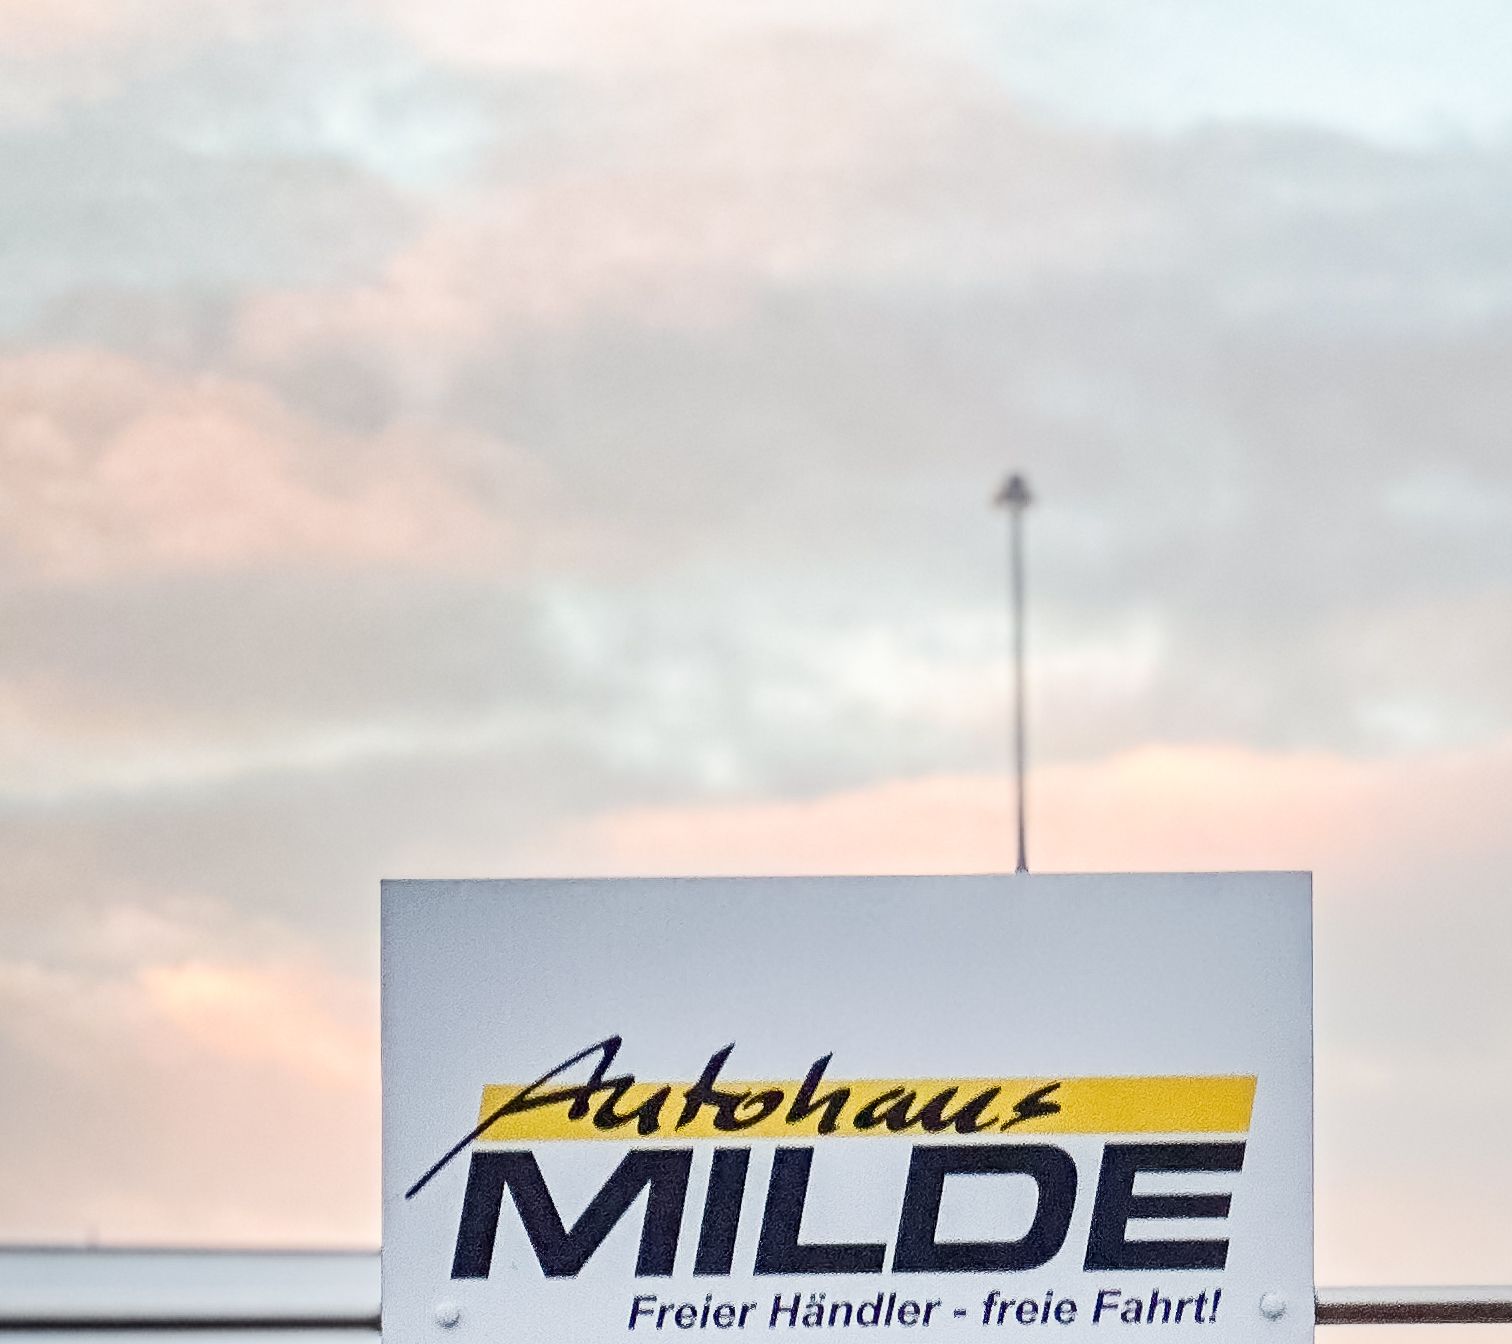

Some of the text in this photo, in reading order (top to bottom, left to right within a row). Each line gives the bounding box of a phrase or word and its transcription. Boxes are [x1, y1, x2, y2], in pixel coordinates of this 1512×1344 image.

[405, 1034, 1062, 1200] Autohaus
[450, 1141, 1248, 1280] MILDE
[627, 1292, 758, 1330] Freier
[768, 1289, 943, 1329] Händler
[982, 1287, 1079, 1326] freie
[1091, 1286, 1222, 1325] Fahrt!
